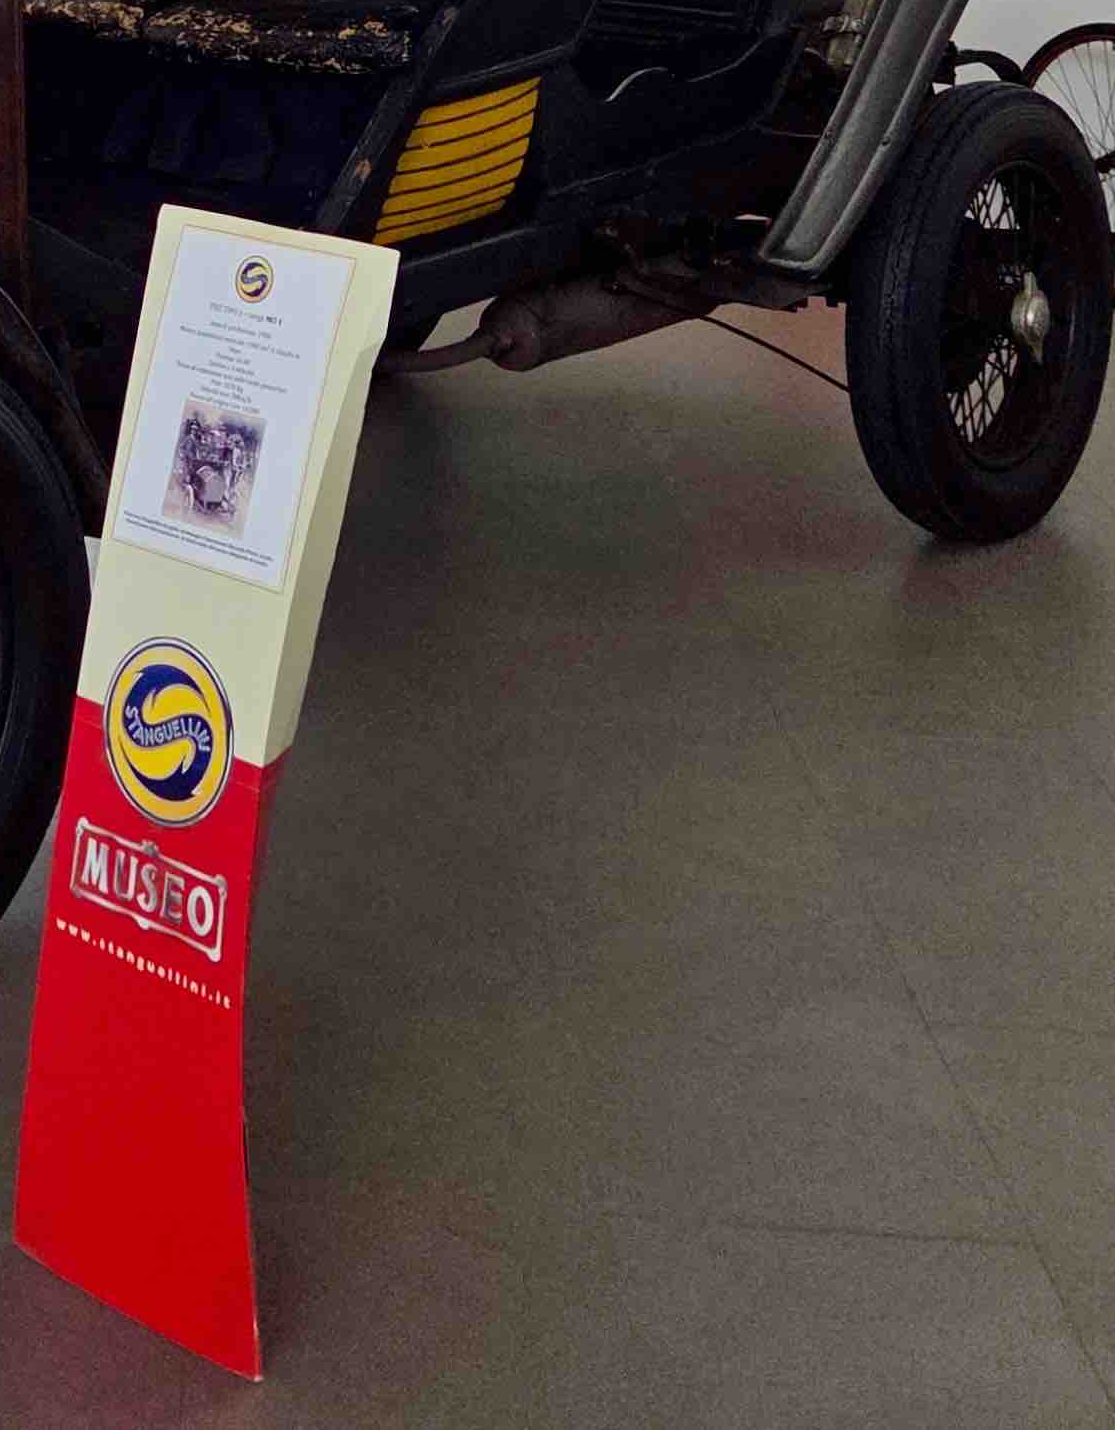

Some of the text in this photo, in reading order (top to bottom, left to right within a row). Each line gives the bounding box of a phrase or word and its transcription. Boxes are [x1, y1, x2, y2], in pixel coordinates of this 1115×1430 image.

[125, 705, 211, 752] STANGUELLINI
[81, 836, 214, 937] MUSEO
[56, 917, 232, 1010] www.stanguellini.it
